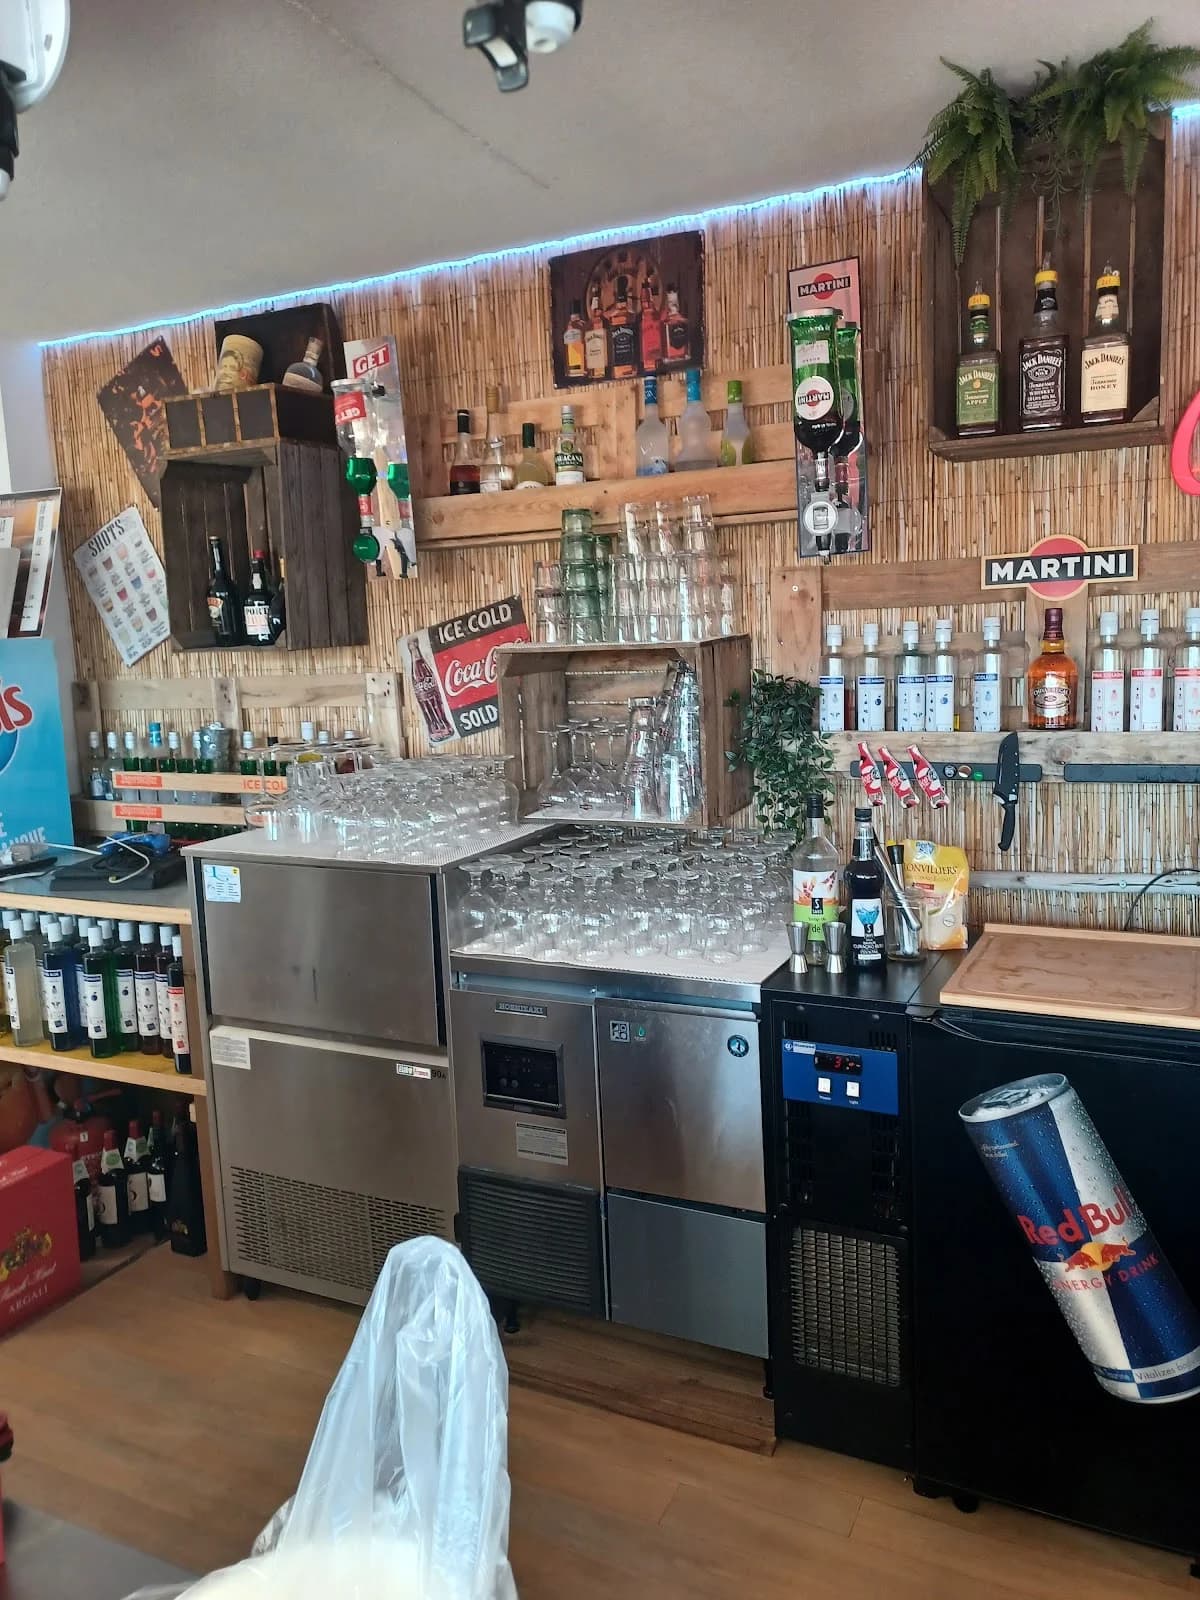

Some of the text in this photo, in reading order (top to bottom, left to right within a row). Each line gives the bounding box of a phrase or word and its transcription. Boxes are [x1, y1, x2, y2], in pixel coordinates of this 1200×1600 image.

[798, 277, 850, 297] MARTINI
[354, 347, 387, 375] GET
[1022, 357, 1038, 372] JACK
[1085, 357, 1100, 370] JACK
[959, 372, 974, 386] JACK
[797, 391, 831, 406] MARTINI
[87, 519, 126, 558] SHOTS
[991, 552, 1127, 582] MARTINI
[438, 603, 513, 644] ICE COLD
[459, 704, 499, 731] SOLD
[243, 779, 287, 791] ICE COL
[811, 924, 821, 933] de
[834, 1056, 842, 1070] 3
[1016, 1185, 1133, 1246] Red Bull
[1051, 1252, 1160, 1292] ENERGY DRINK
[1135, 1366, 1176, 1380] Vitalizes
